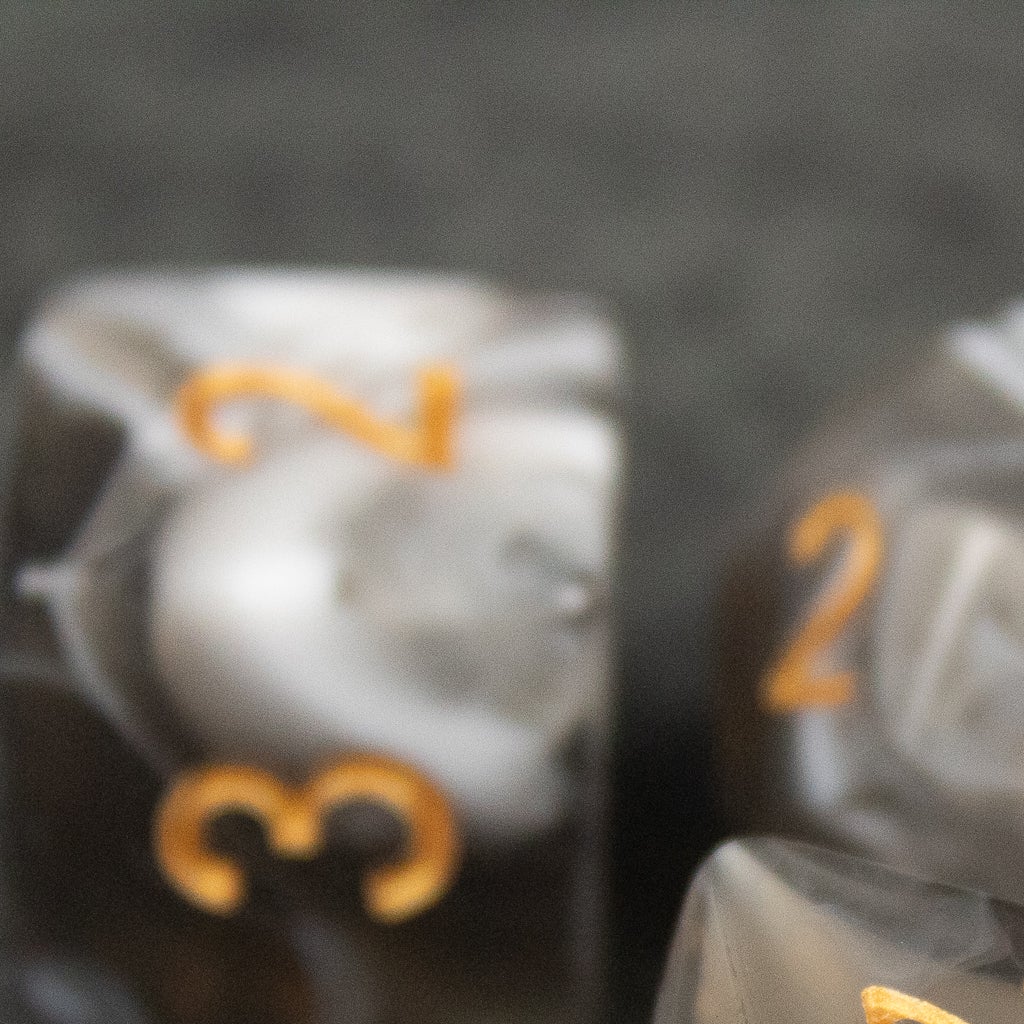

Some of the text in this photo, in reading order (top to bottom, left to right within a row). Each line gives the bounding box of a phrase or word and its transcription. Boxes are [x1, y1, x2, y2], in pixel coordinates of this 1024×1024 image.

[175, 360, 463, 474] 2
[762, 488, 886, 714] 2
[156, 752, 459, 922] 3
